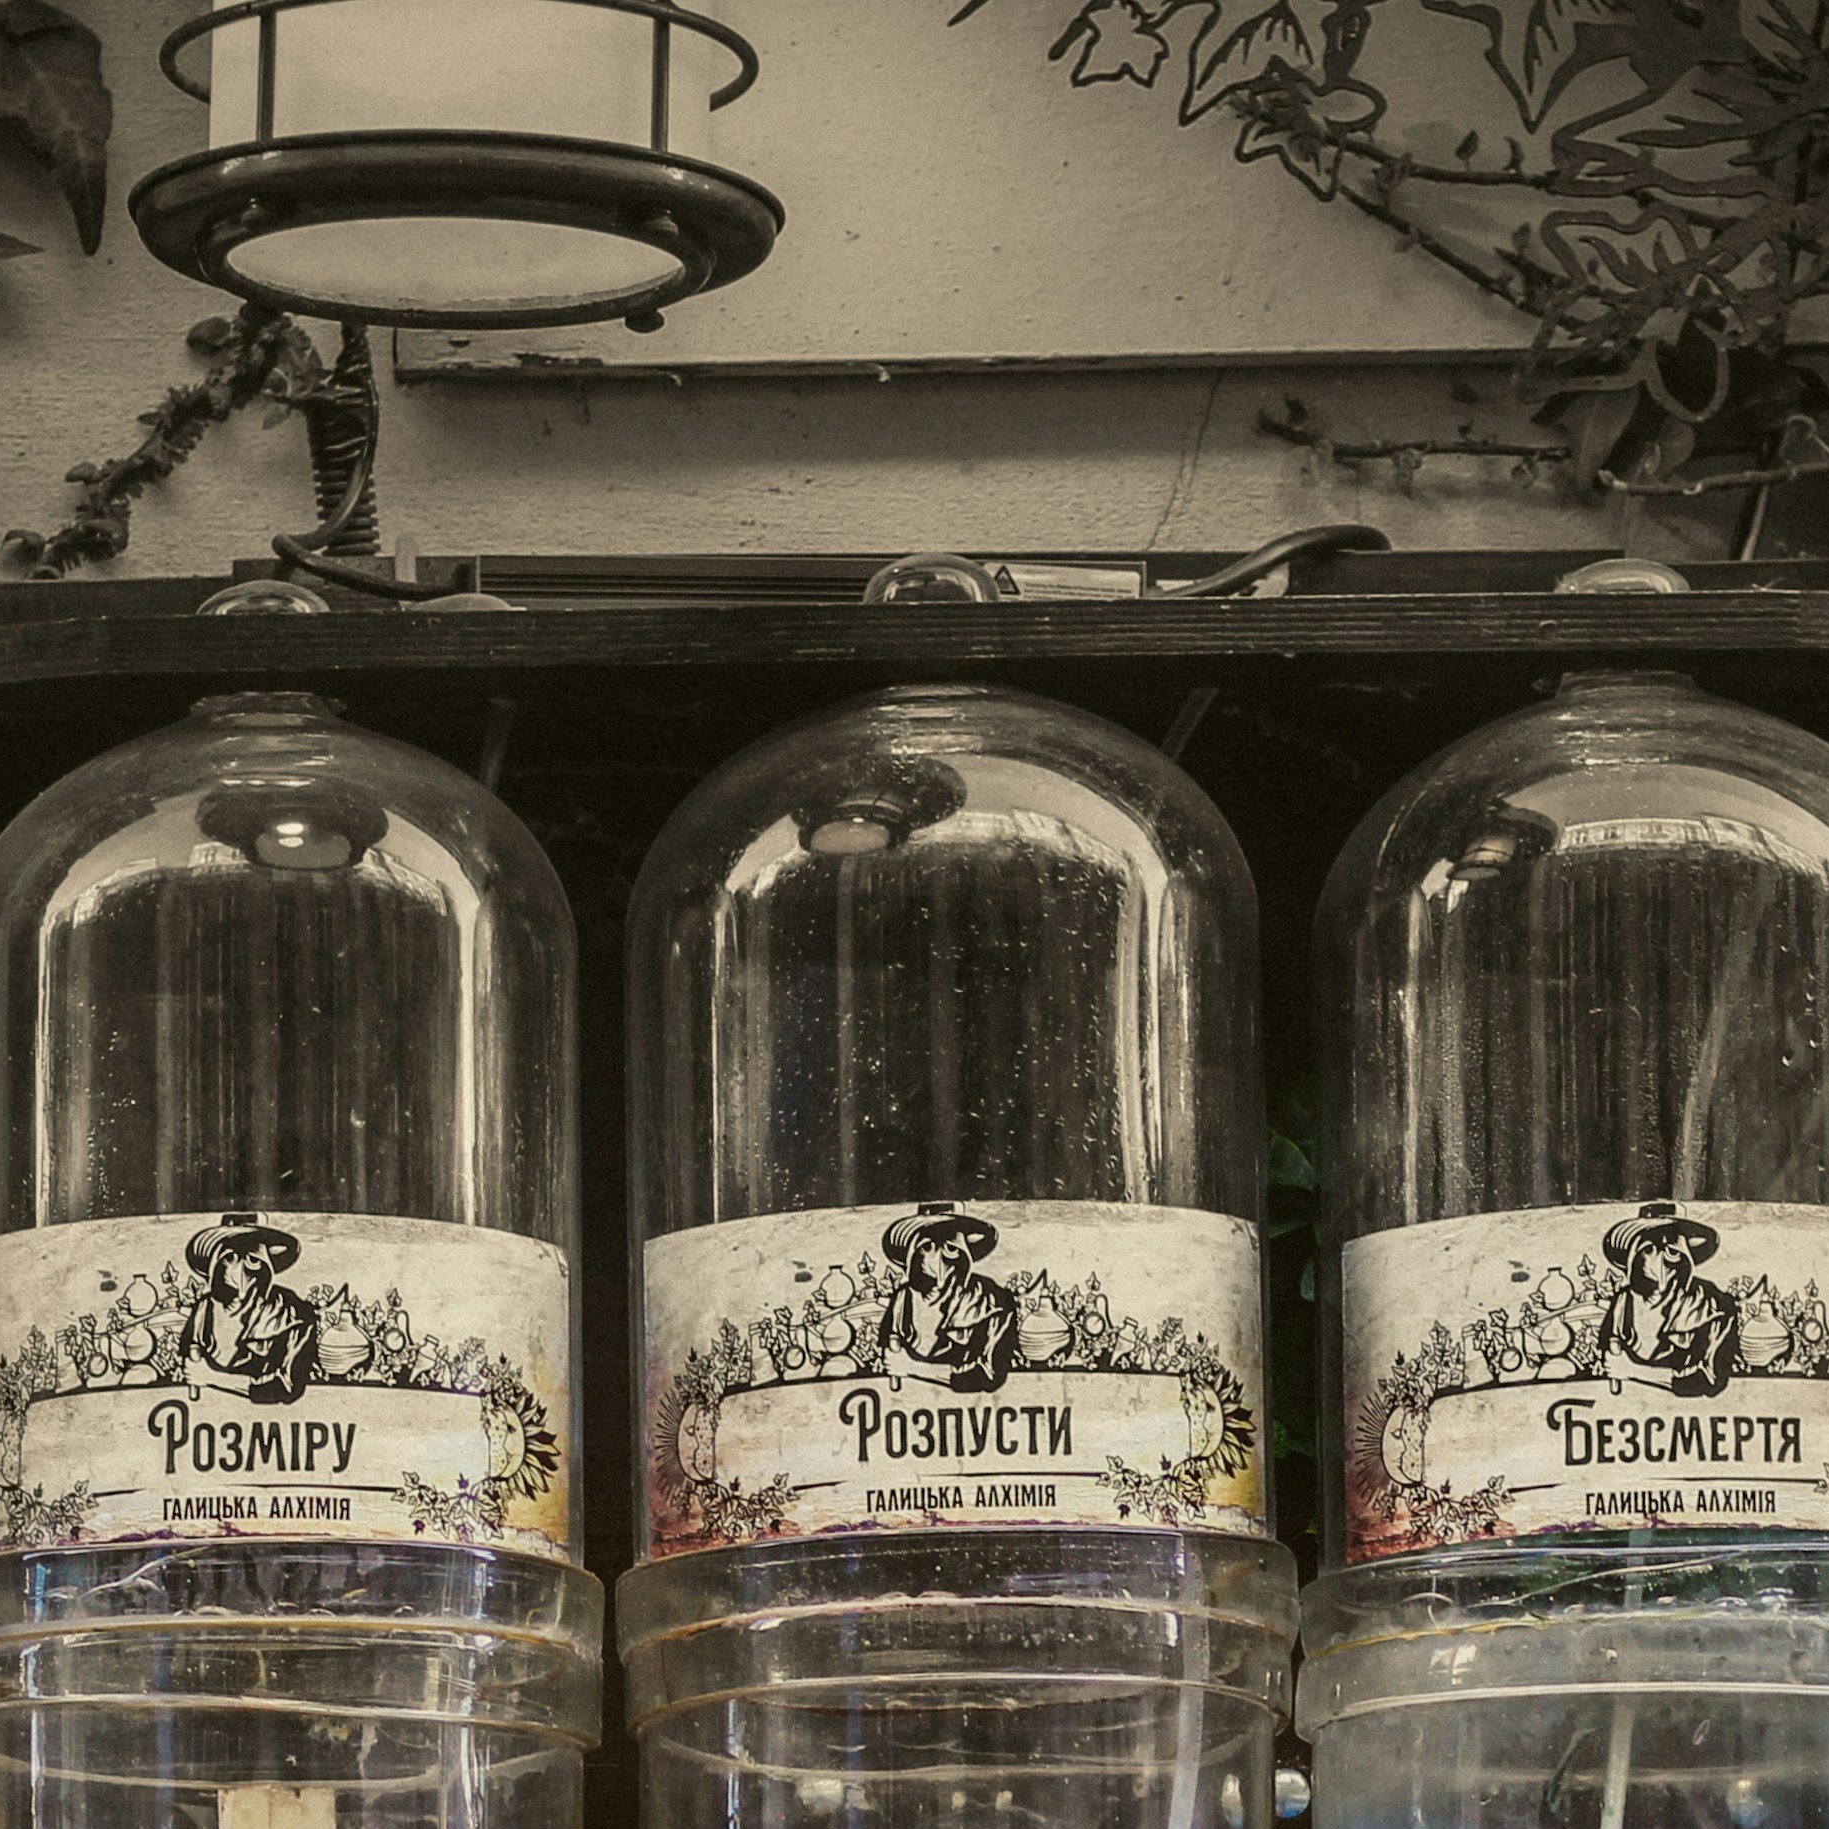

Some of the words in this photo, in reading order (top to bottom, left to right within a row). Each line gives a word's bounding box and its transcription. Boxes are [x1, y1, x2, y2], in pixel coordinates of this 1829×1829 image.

[147, 1399, 356, 1474] РОЗМІРУ
[838, 1388, 1073, 1462] РОЗПУСТИ
[1546, 1398, 1802, 1466] БЕЗСМЕРТЯ
[162, 1496, 258, 1522] ГАЛИЦЬКА
[269, 1496, 352, 1521] АЛХІМІЯ
[866, 1486, 964, 1514] ГАЛИЦЬКА
[974, 1484, 1057, 1509] АЛХІМІЯ
[1585, 1490, 1685, 1518] ГАЛИЦЬКА
[1695, 1489, 1776, 1514] АЛХІМІЯ
